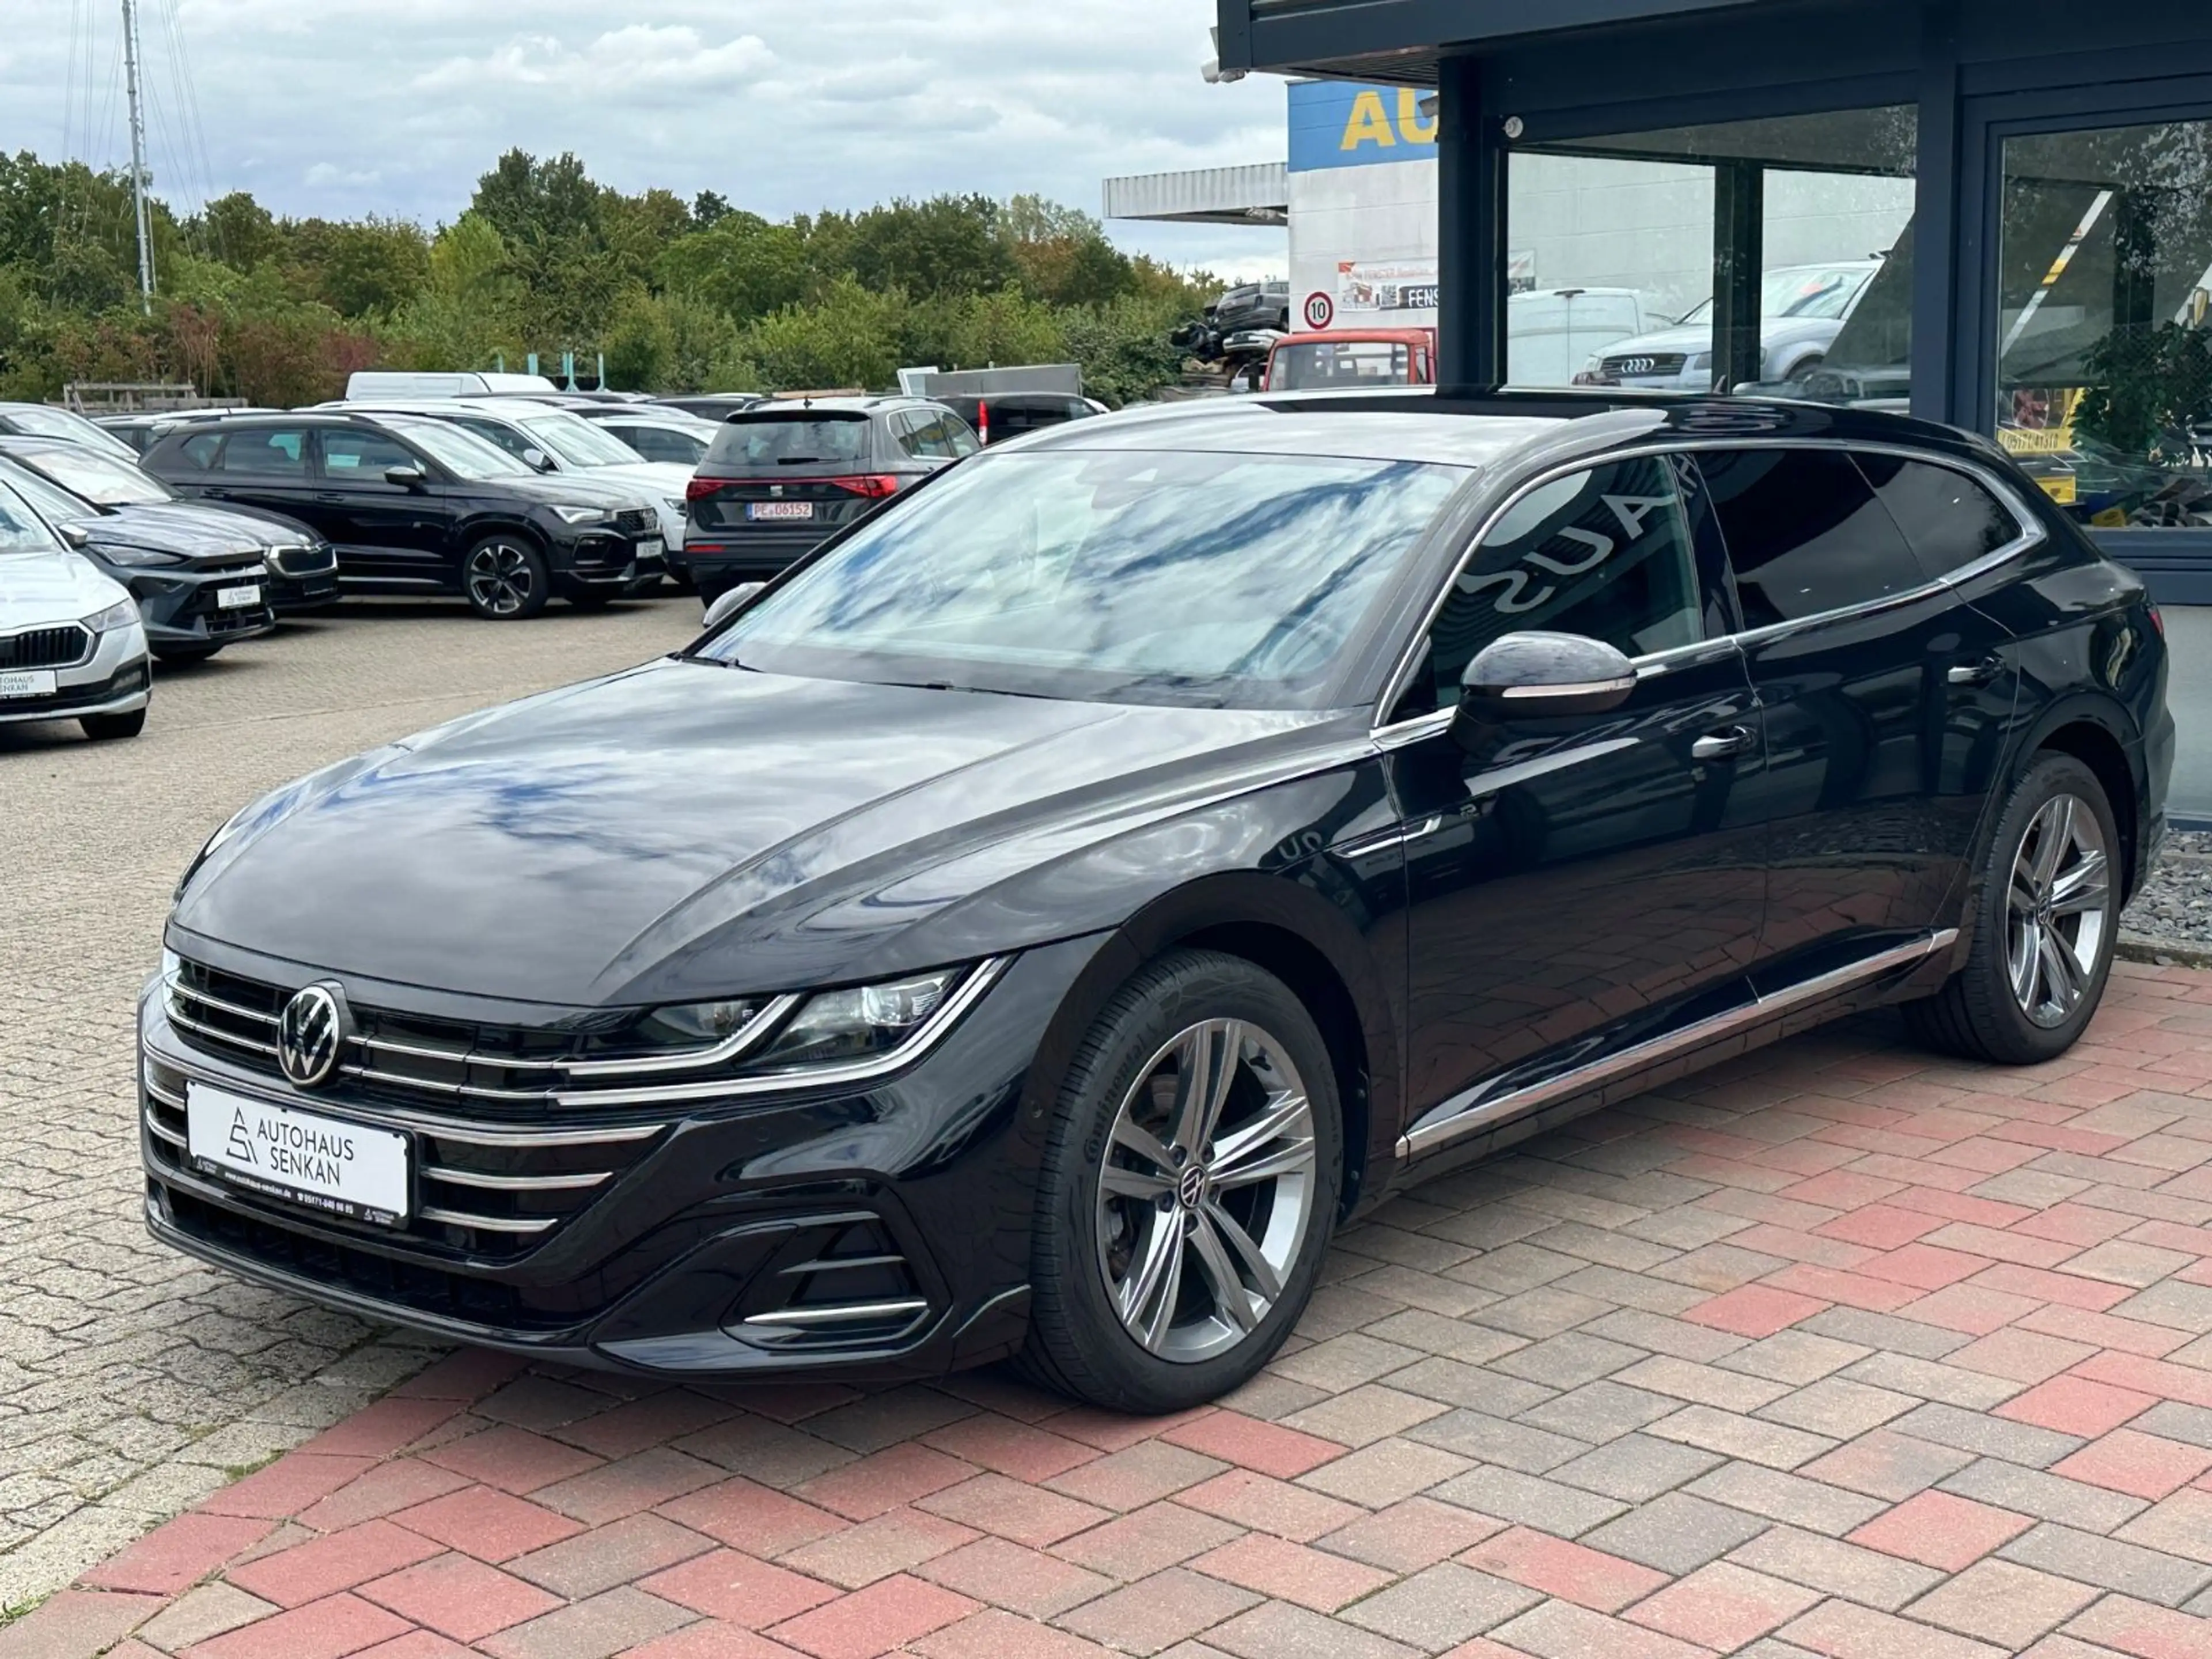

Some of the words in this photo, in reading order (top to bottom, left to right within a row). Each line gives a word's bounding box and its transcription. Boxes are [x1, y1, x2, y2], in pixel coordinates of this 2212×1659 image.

[1311, 302, 1325, 320] 10
[755, 504, 768, 515] PE
[257, 1118, 354, 1161] AUTOHAUS
[271, 1146, 340, 1186] SENKAN
